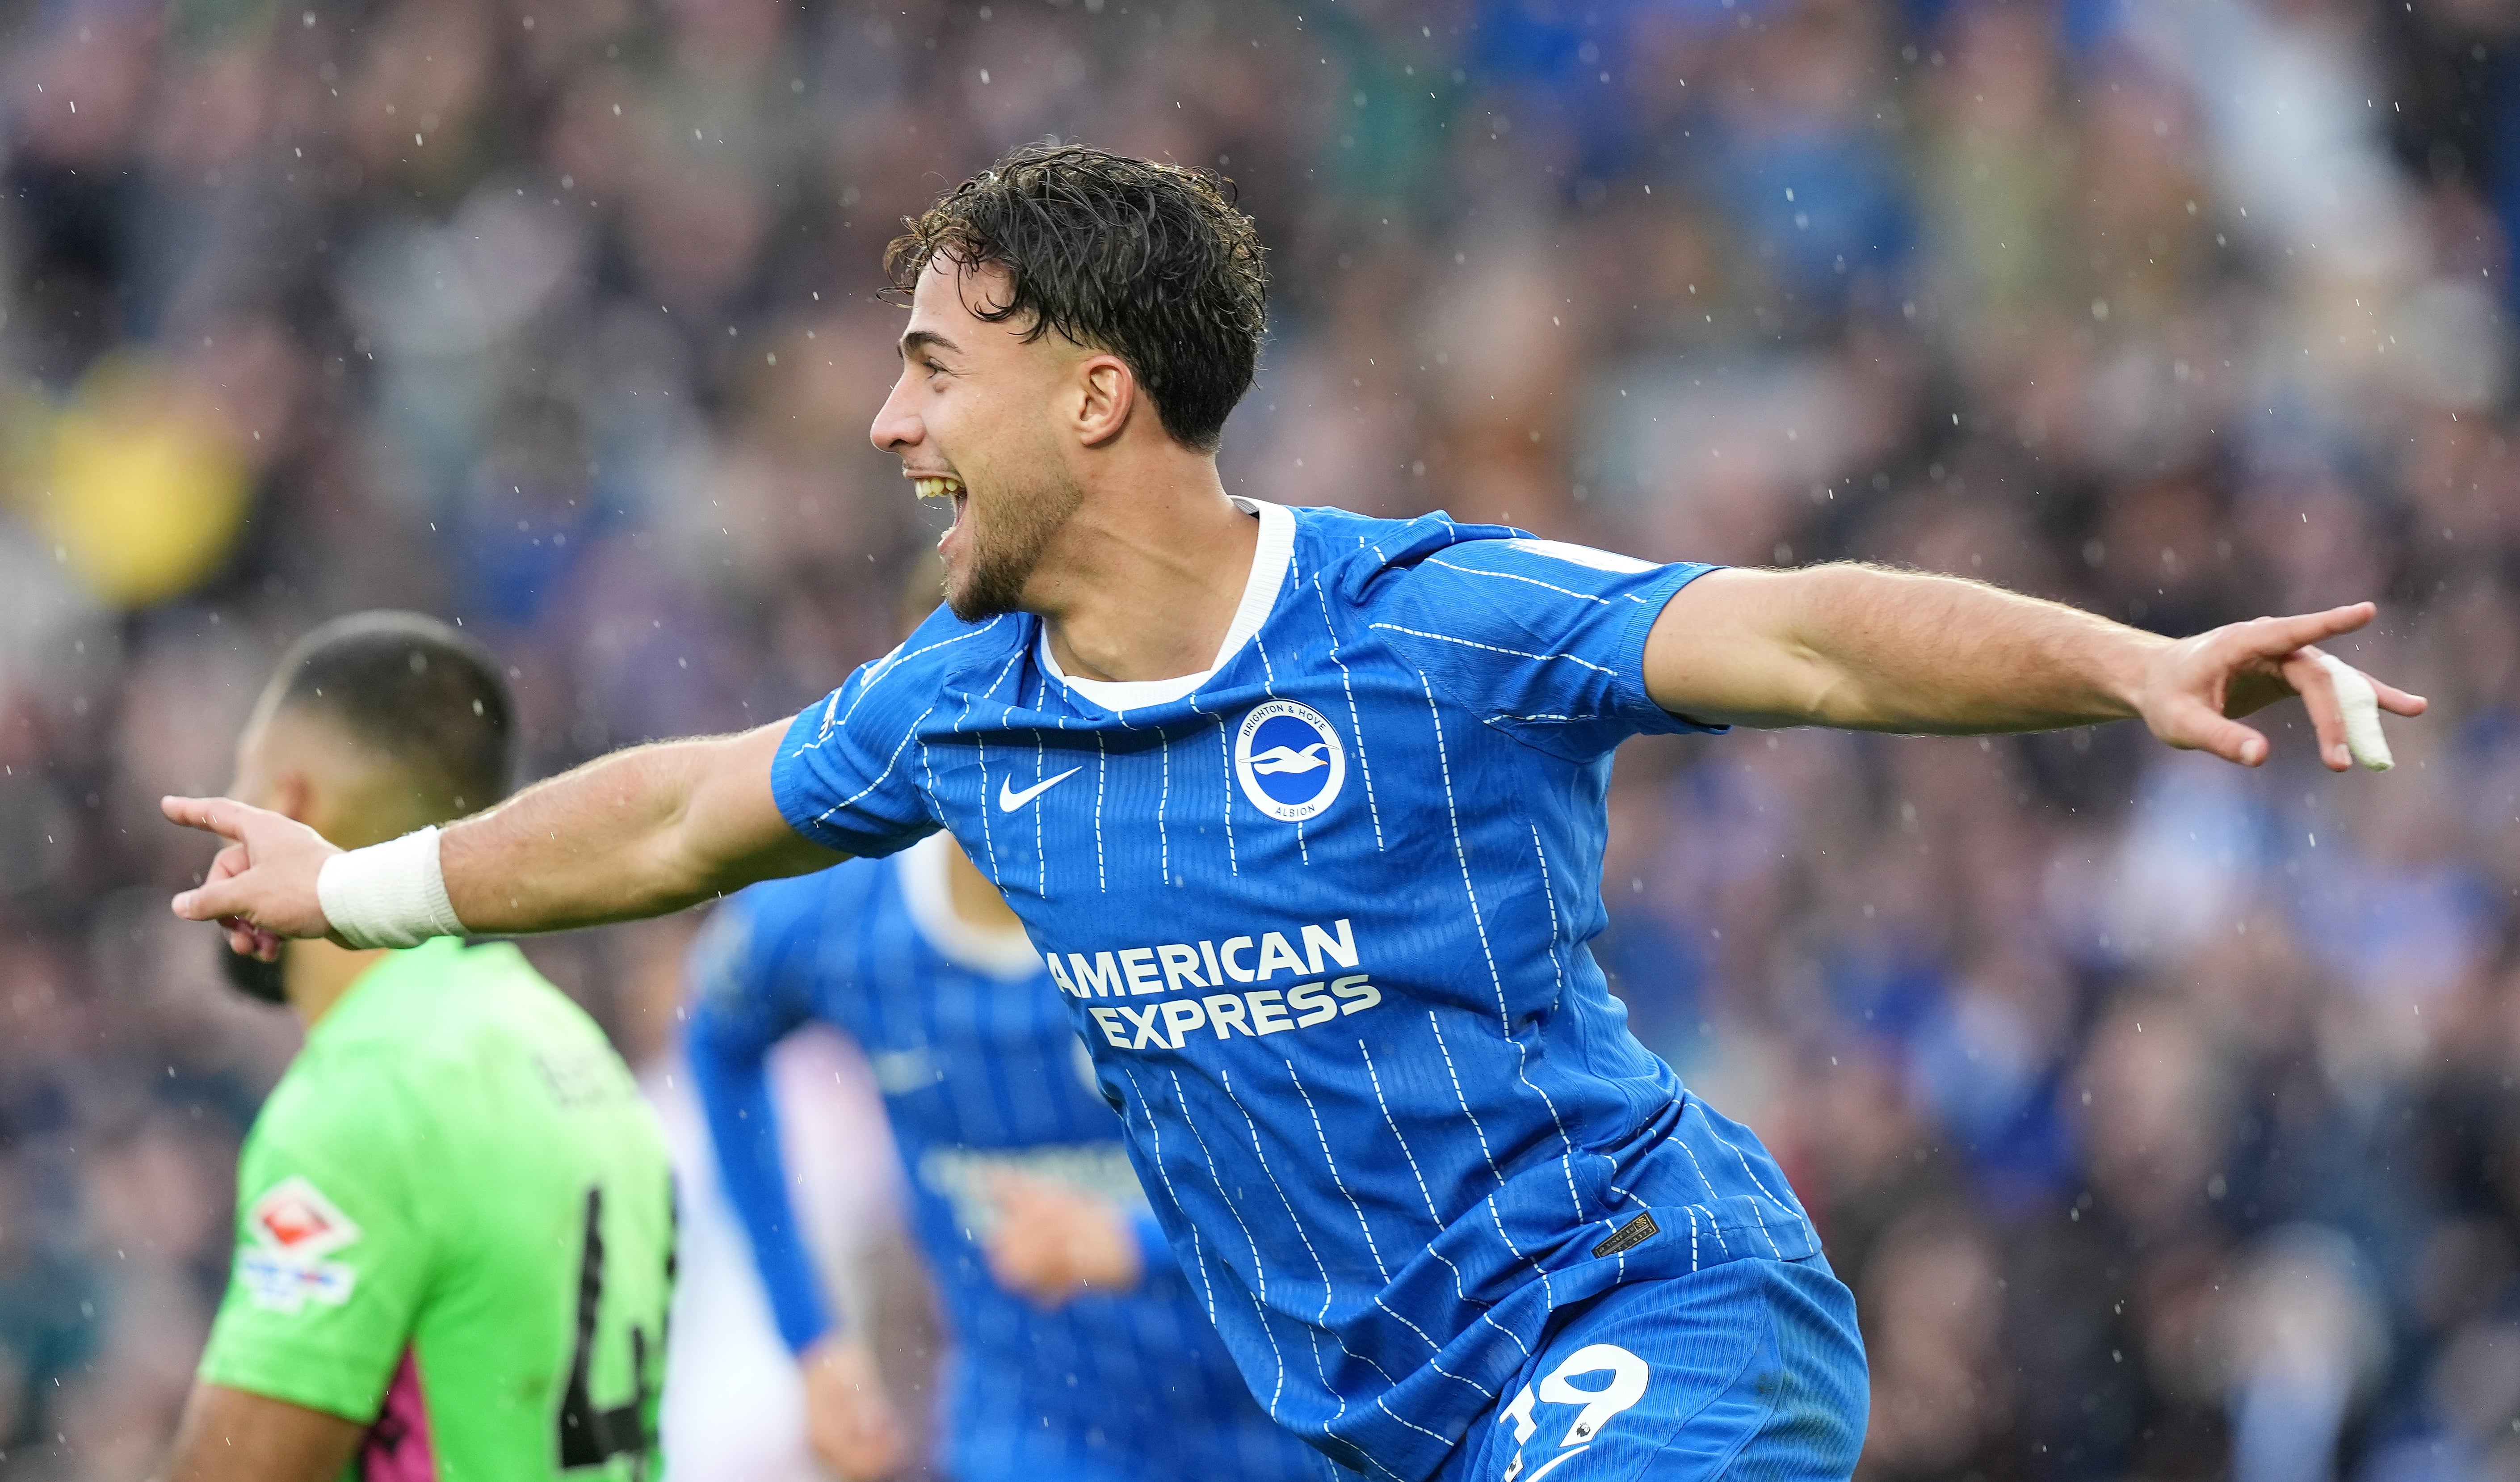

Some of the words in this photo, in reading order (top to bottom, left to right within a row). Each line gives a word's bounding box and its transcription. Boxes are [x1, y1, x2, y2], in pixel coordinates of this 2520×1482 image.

[1243, 704, 1284, 737] BRIGHTON
[1299, 709, 1326, 731] HOVE
[1275, 804, 1315, 817] ALBION
[1046, 918, 1360, 998] AMERICAN
[1088, 974, 1382, 1050] EXPRESS
